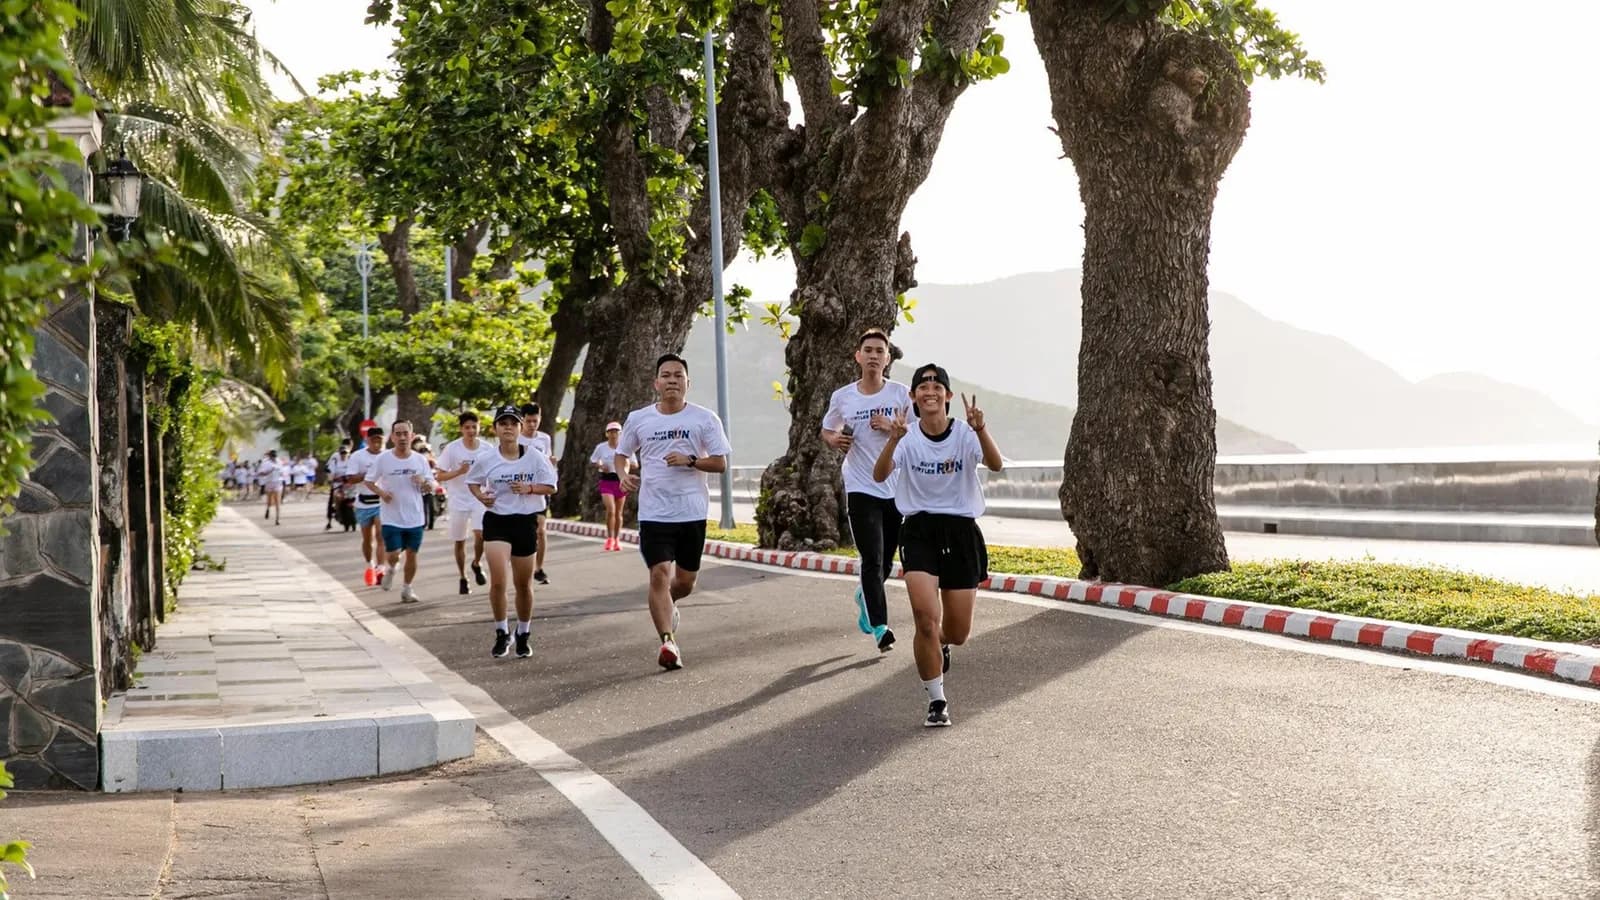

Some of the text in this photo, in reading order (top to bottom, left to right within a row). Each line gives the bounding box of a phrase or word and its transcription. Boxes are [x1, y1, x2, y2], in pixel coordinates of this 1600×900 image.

[668, 429, 690, 440] RUN
[937, 459, 963, 475] RUN
[514, 472, 535, 482] RUN
